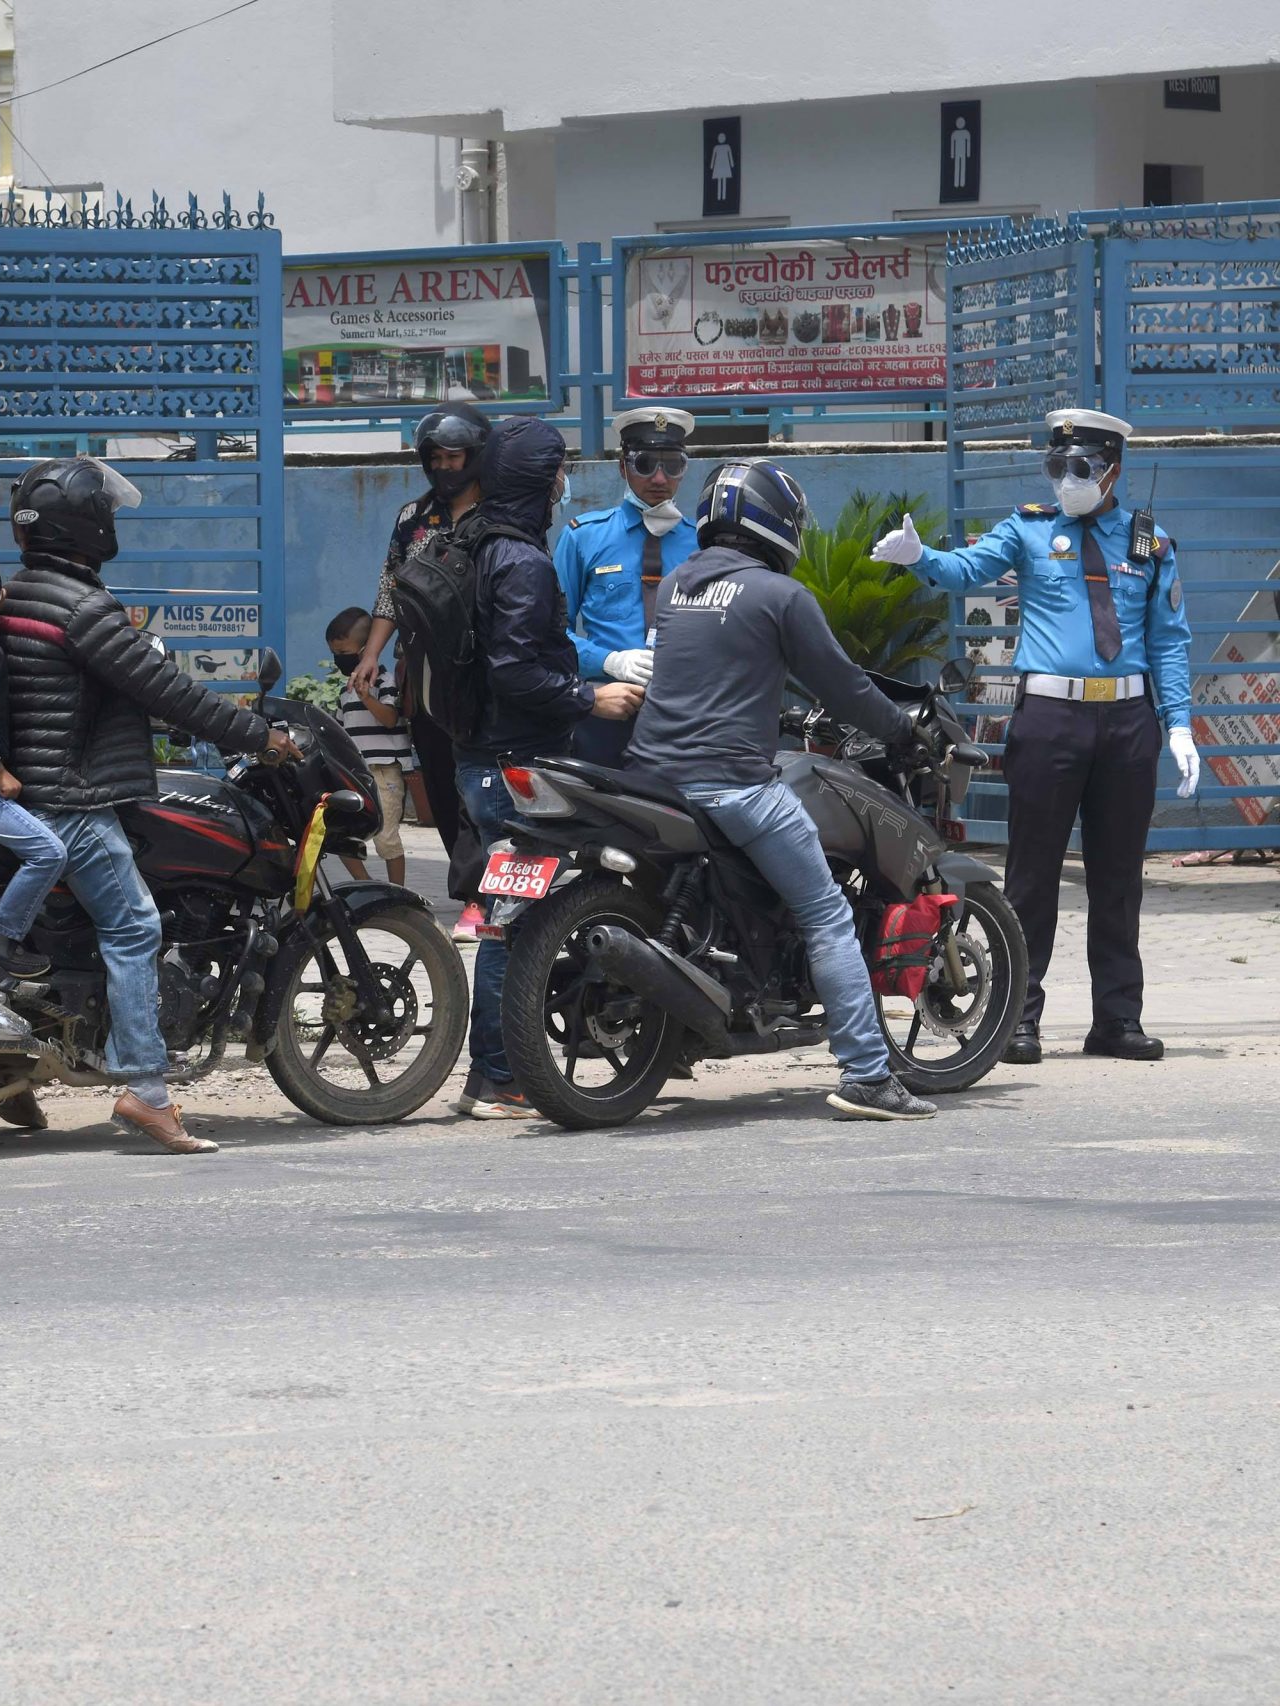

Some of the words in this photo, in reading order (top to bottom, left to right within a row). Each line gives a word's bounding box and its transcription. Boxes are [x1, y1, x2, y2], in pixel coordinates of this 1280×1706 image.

[1191, 78, 1216, 95] ROOM
[825, 247, 911, 281] ज्वेलर्स
[282, 273, 378, 308] AME
[387, 266, 534, 304] ARENA
[796, 286, 833, 301] गहना
[330, 311, 370, 325] Games
[373, 309, 384, 323] &
[387, 307, 455, 323] Accessories
[340, 328, 375, 340] Sumeru
[377, 327, 402, 338] Mart,
[429, 328, 447, 336] Floor
[163, 605, 204, 621] Kids
[210, 605, 258, 622] Zone
[163, 622, 197, 632] Contact:
[198, 623, 245, 632] 9840798817
[484, 872, 546, 895] ७०४१
